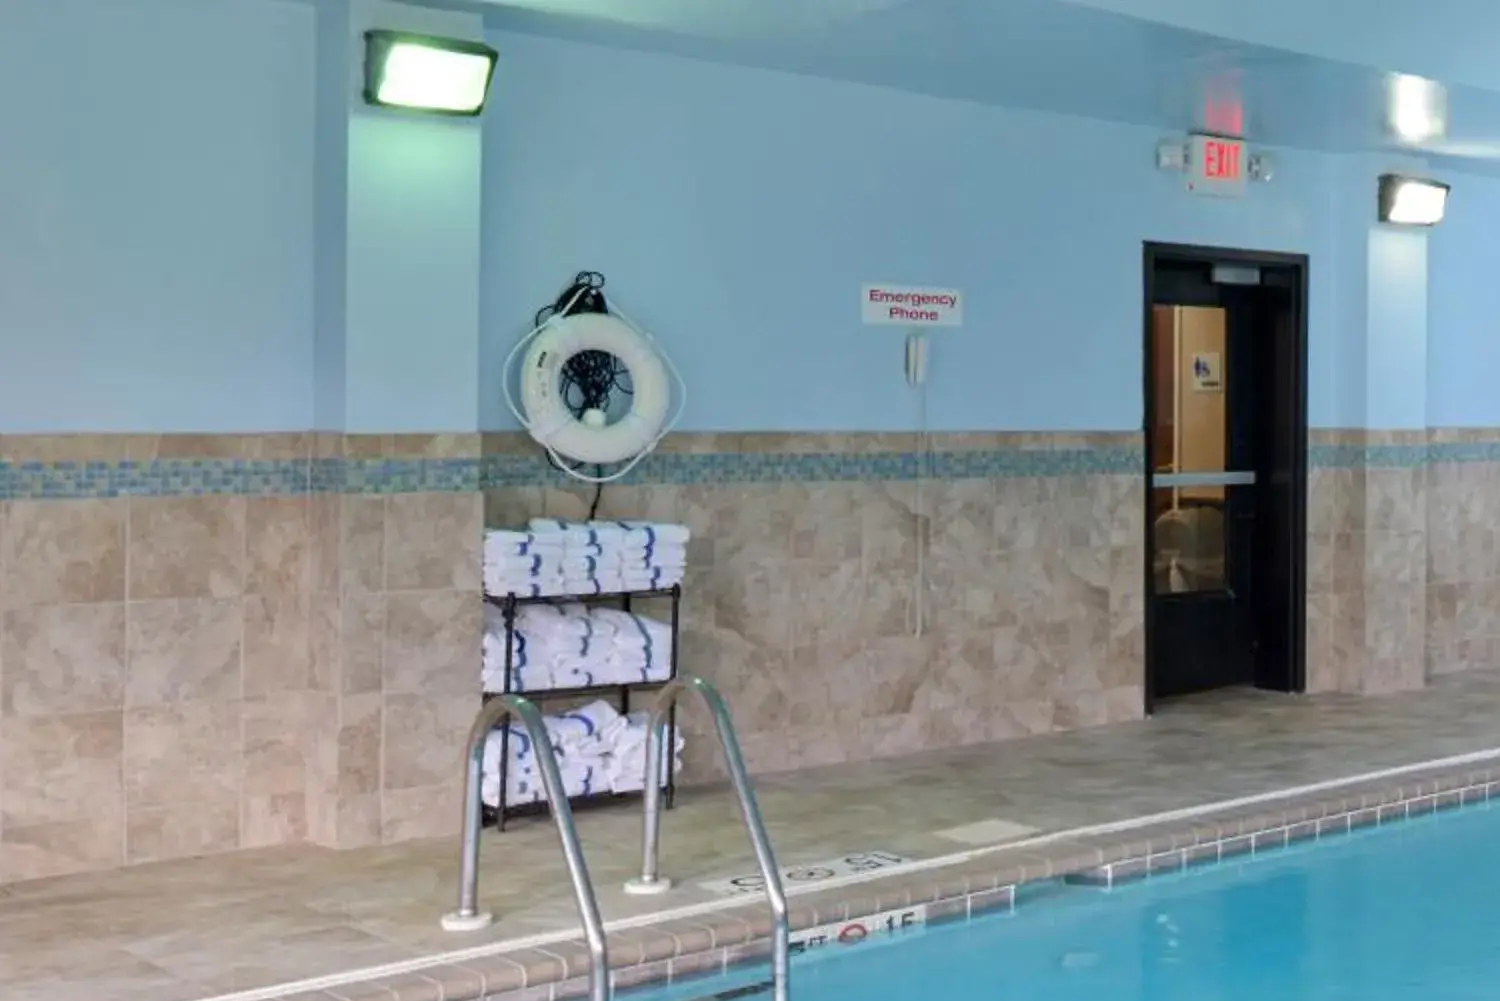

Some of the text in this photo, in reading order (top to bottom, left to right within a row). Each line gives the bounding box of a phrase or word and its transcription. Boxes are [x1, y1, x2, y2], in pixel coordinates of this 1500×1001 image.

[1204, 141, 1240, 178] EXIT
[869, 289, 957, 308] Emergency
[889, 307, 939, 321] Phone
